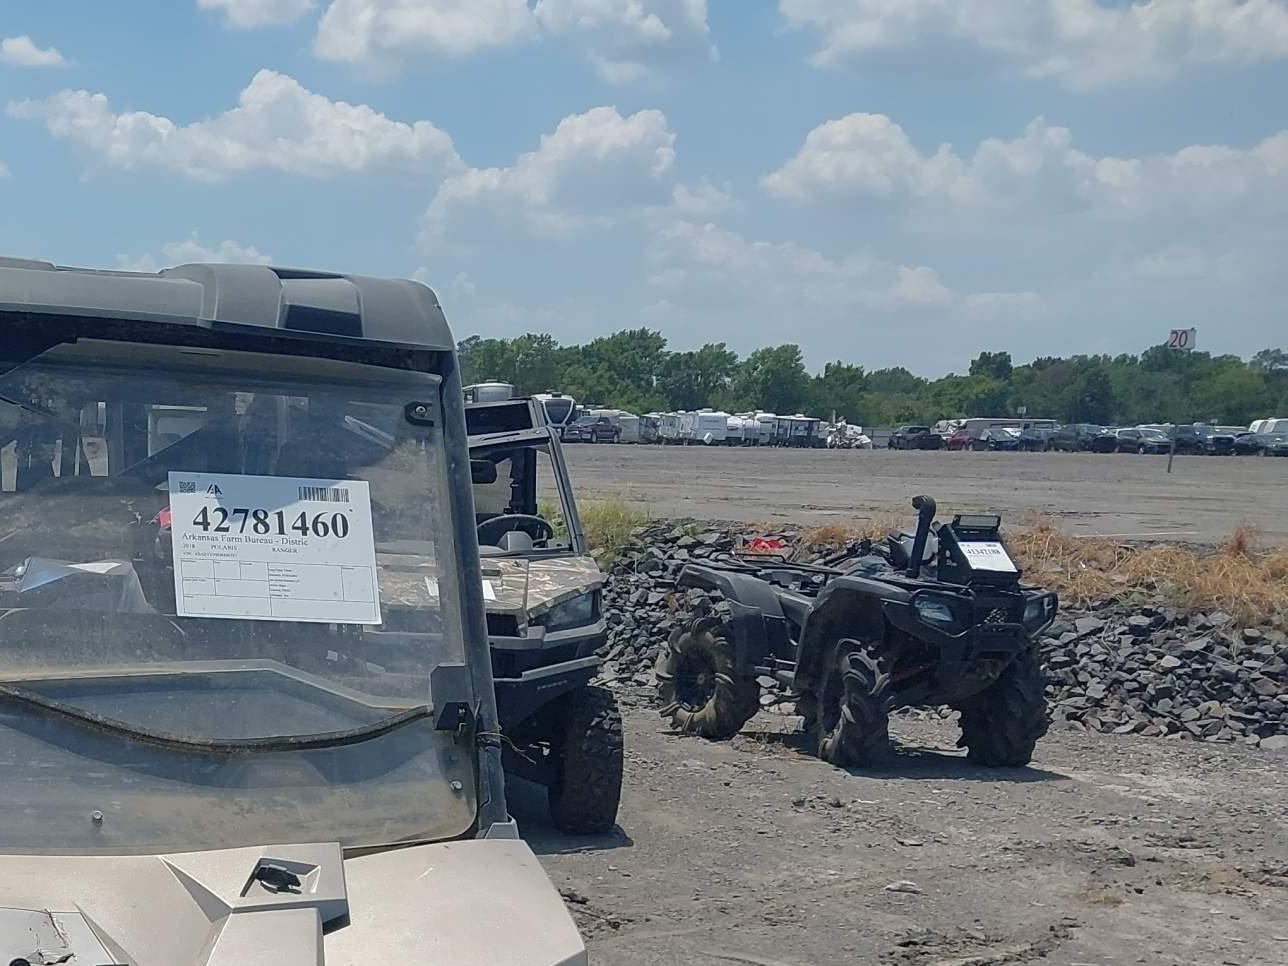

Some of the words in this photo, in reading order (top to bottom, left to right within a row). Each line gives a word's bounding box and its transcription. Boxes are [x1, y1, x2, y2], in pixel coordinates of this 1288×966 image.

[1169, 330, 1188, 347] 20
[193, 506, 349, 539] 42781460
[182, 532, 219, 542] Arkansas
[221, 534, 242, 543] Farm
[244, 535, 273, 545] Bureau
